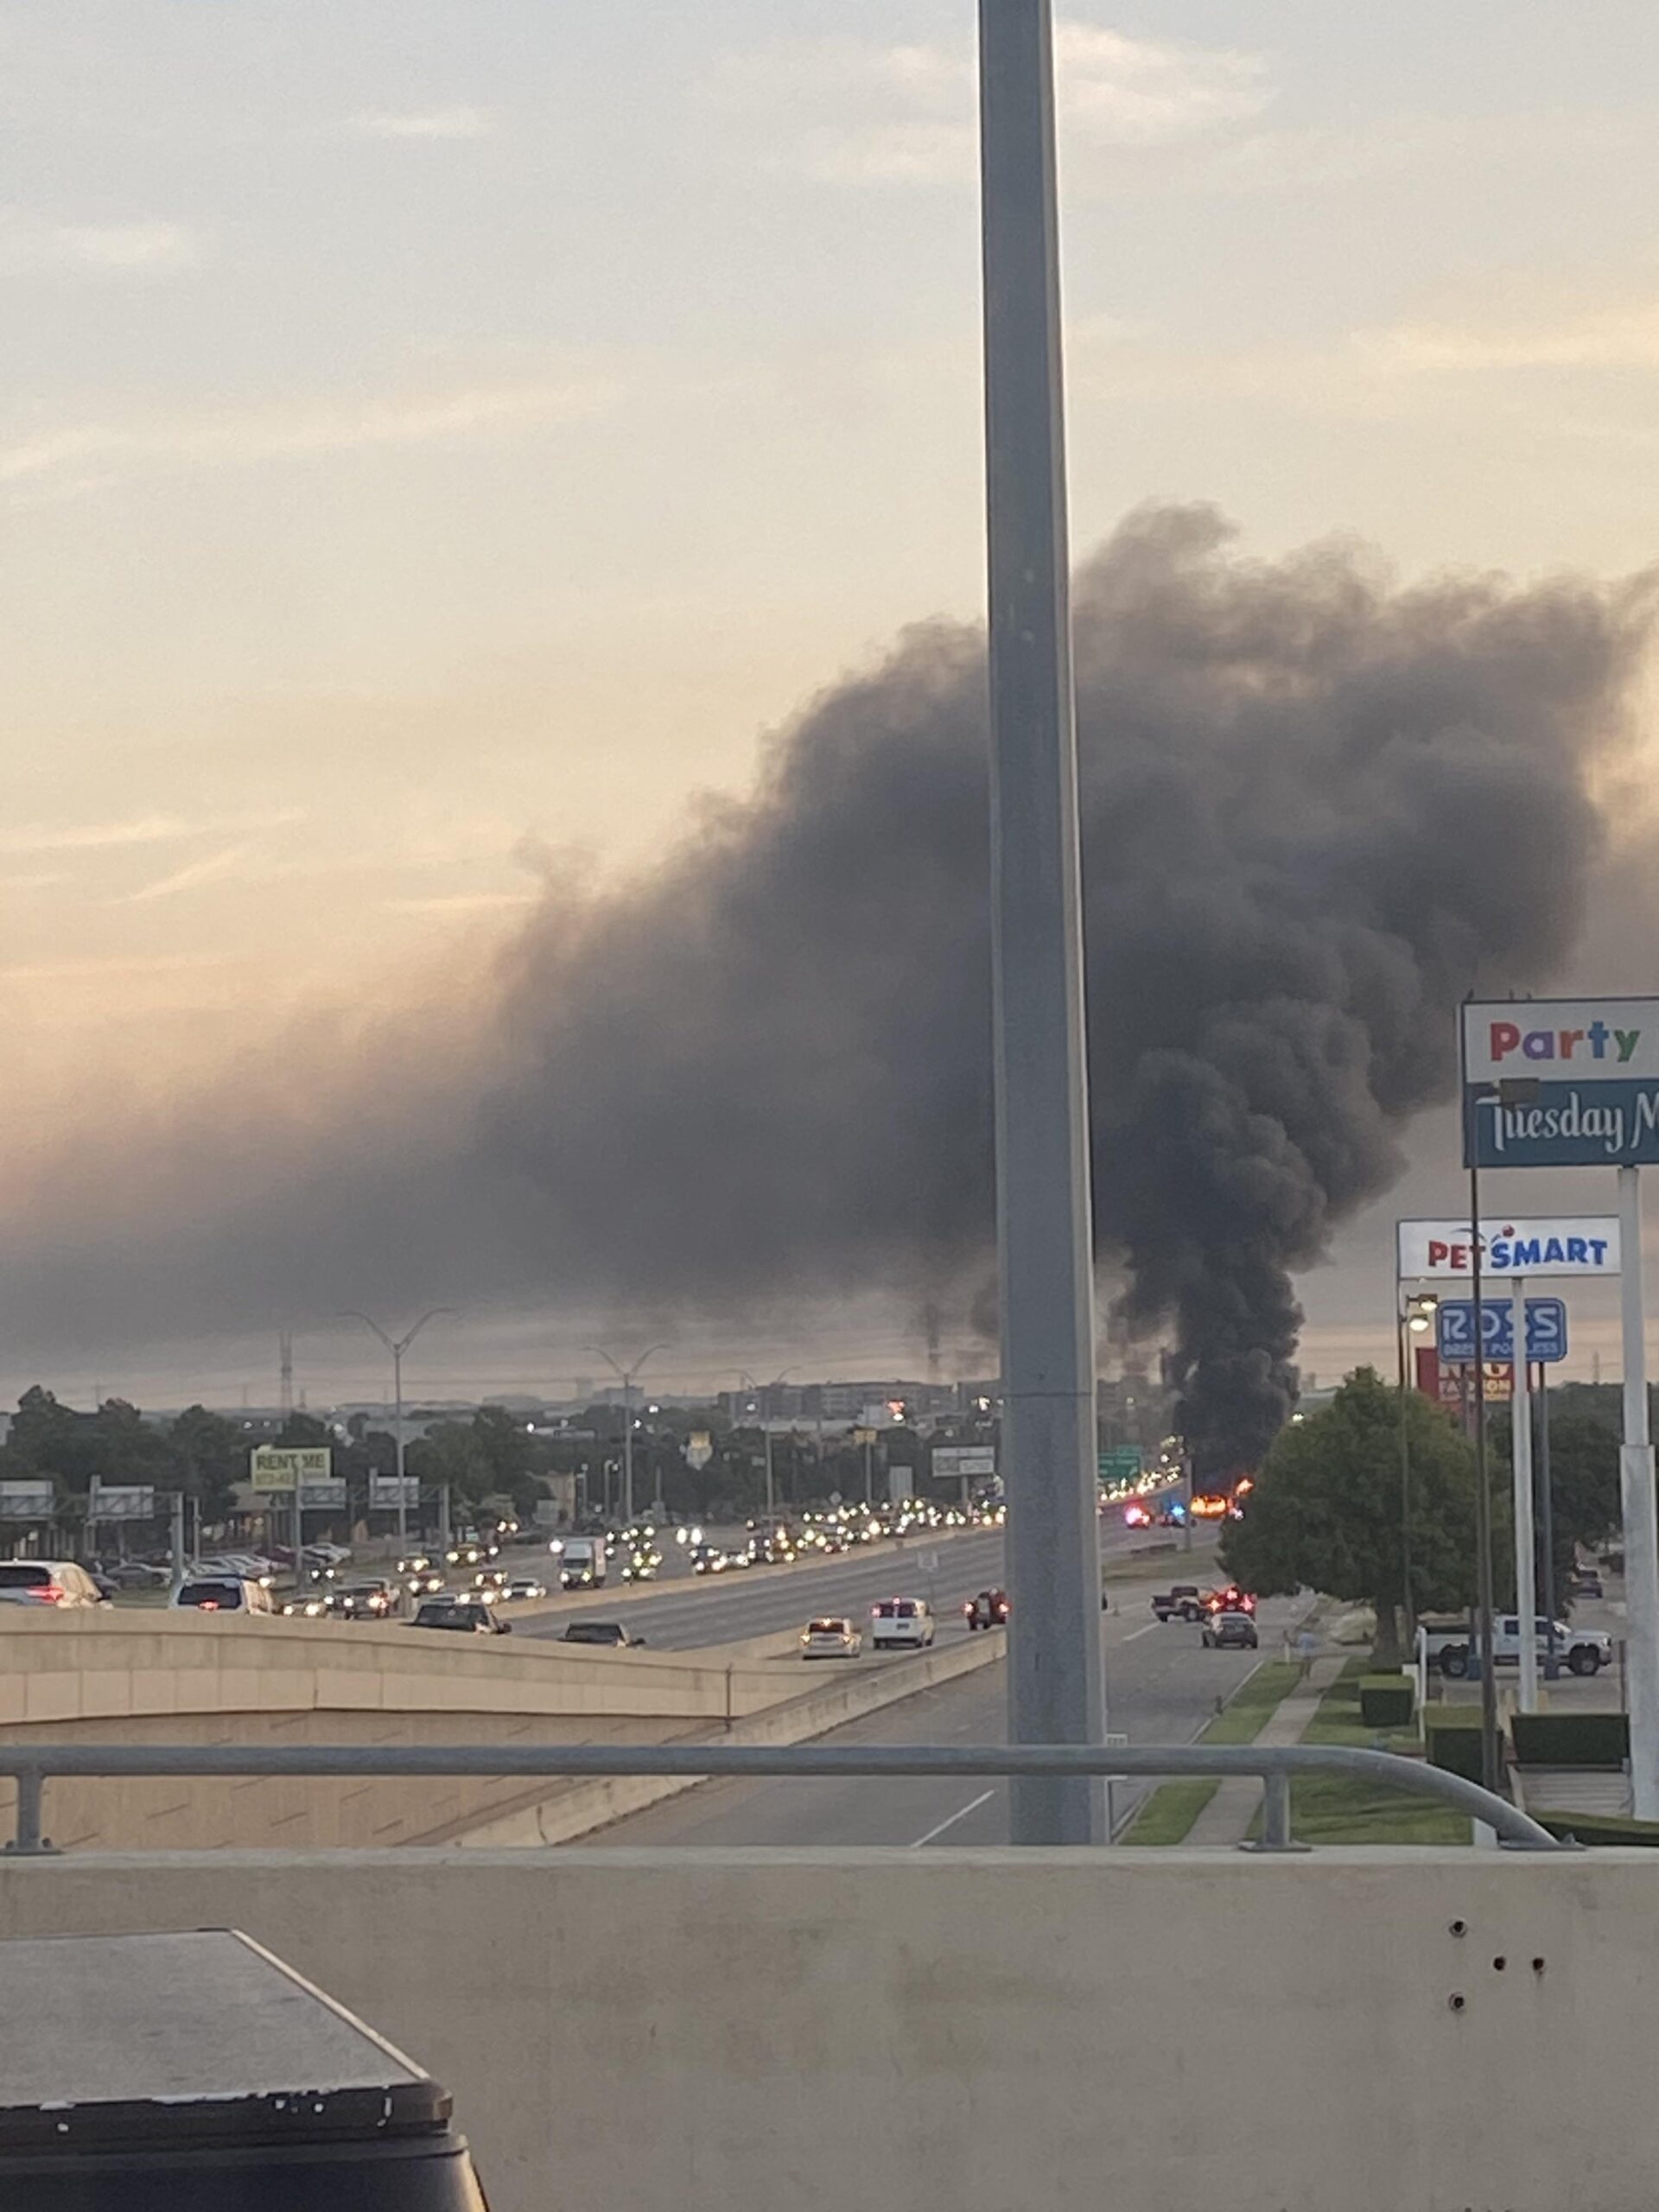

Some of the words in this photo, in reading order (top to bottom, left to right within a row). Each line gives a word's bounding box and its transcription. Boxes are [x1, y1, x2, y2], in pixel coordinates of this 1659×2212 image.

[1491, 1021, 1641, 1062] Party
[1477, 1091, 1624, 1153] Tuesday
[257, 1454, 297, 1470] RENT
[301, 1453, 325, 1469] ME
